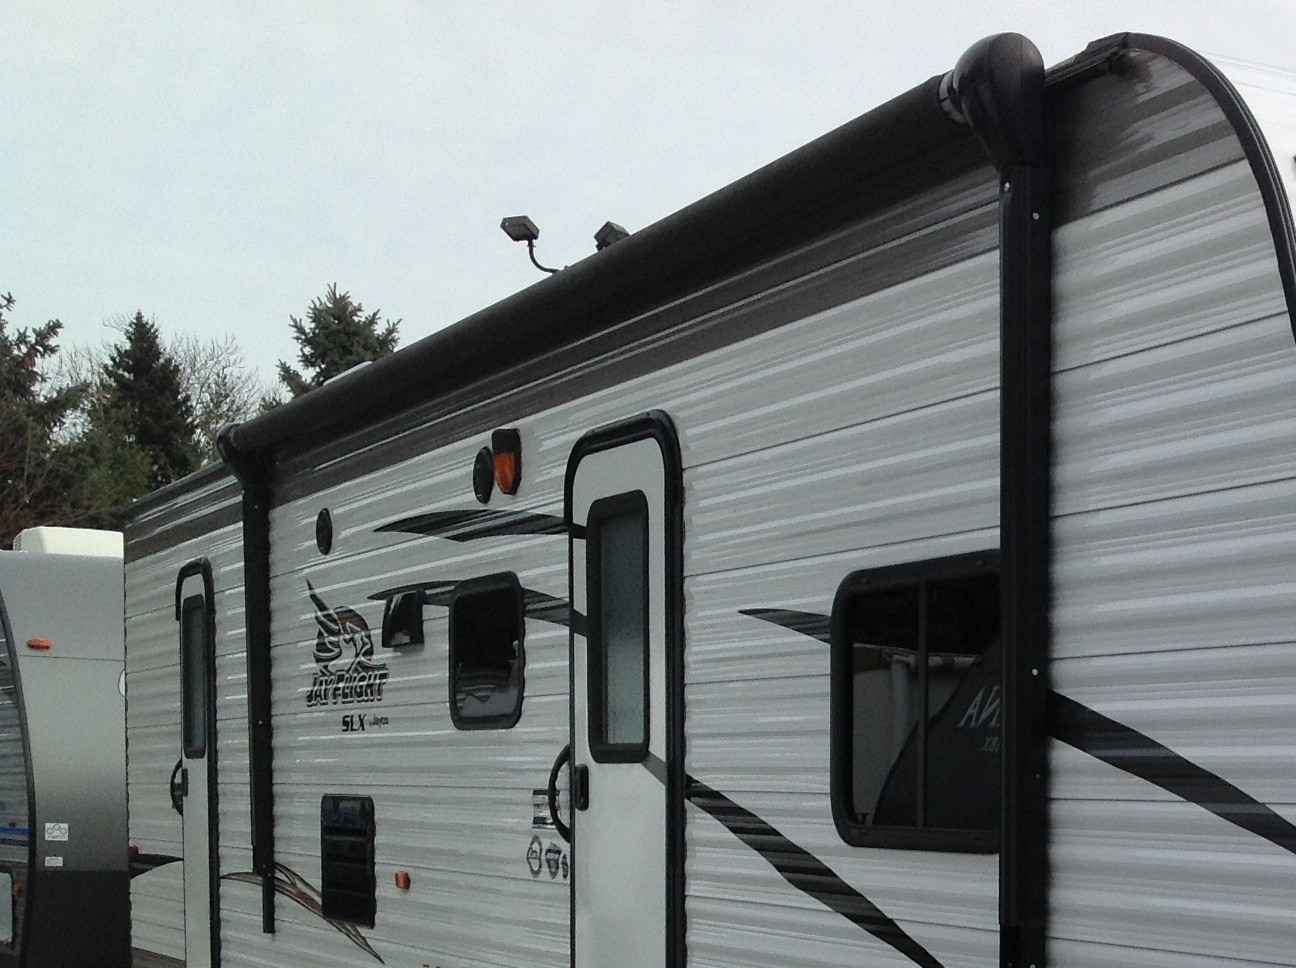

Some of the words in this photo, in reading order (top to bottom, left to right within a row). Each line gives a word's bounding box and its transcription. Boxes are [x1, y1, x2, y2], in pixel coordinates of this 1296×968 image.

[306, 673, 334, 707] JAY
[332, 671, 389, 705] FLIGHT
[341, 714, 366, 732] SLX
